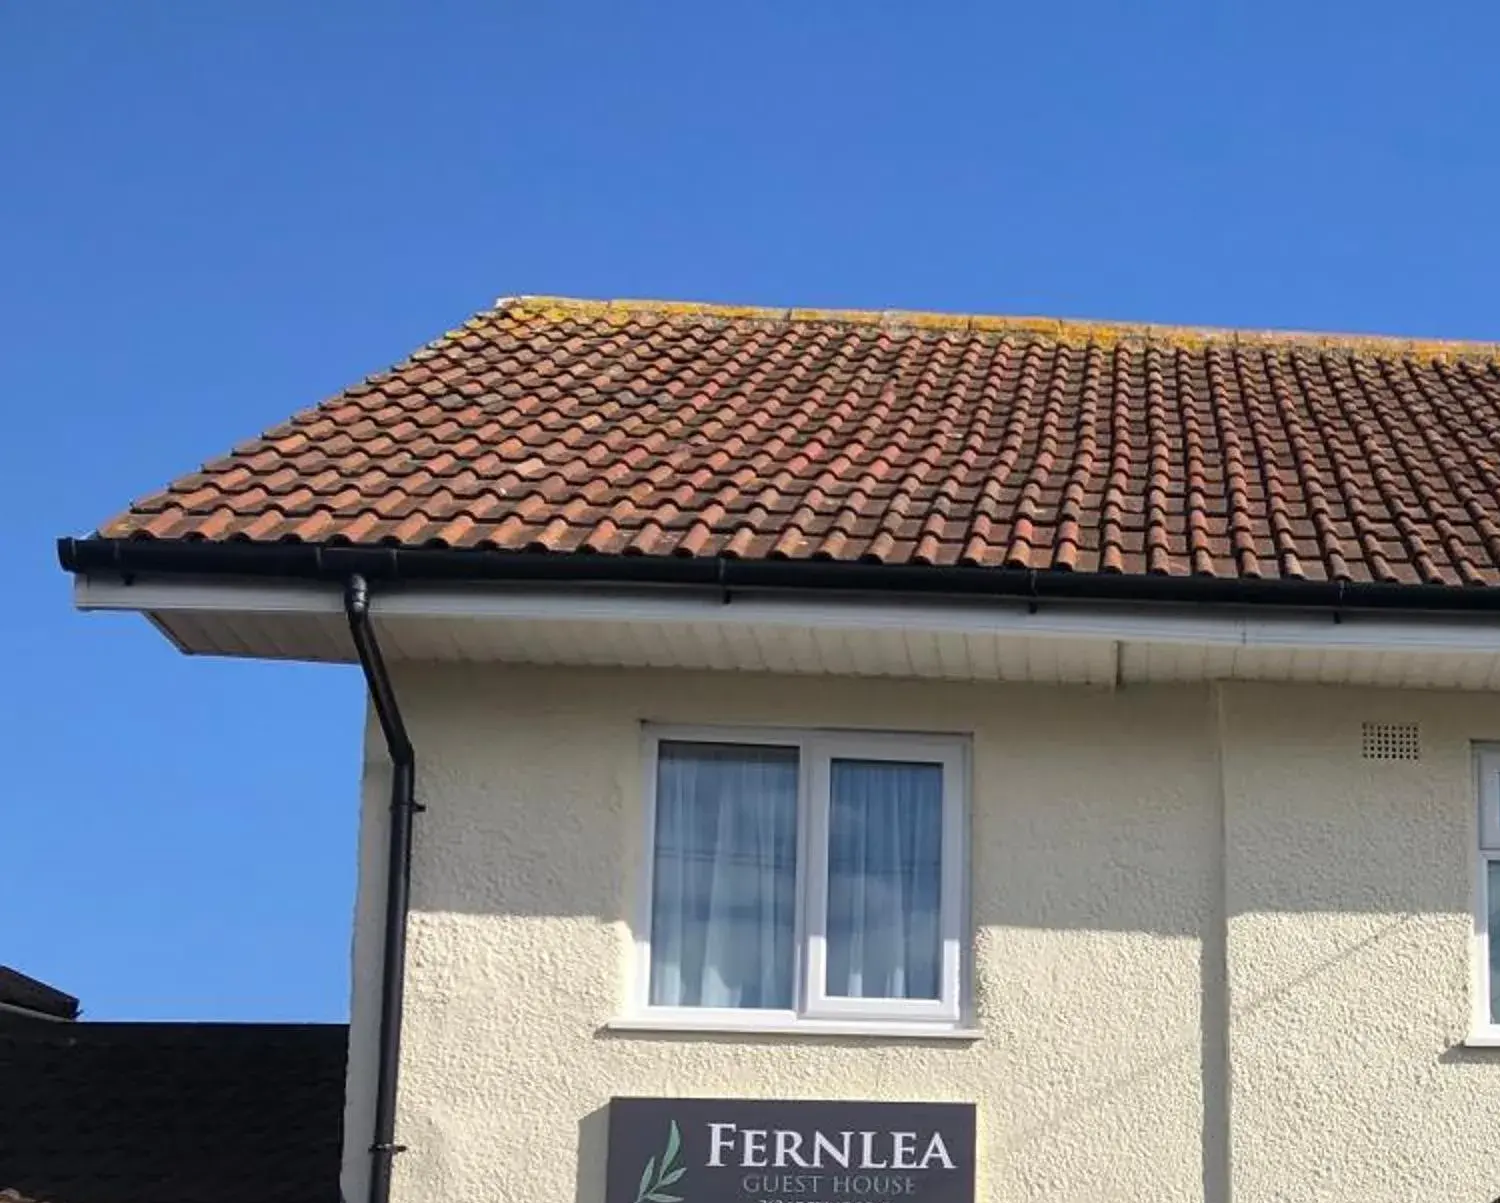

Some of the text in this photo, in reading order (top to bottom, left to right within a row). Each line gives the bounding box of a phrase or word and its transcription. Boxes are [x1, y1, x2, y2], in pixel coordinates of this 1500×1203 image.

[704, 1122, 957, 1169] FERNLEA
[743, 1175, 916, 1195] GUEST HOUSE
